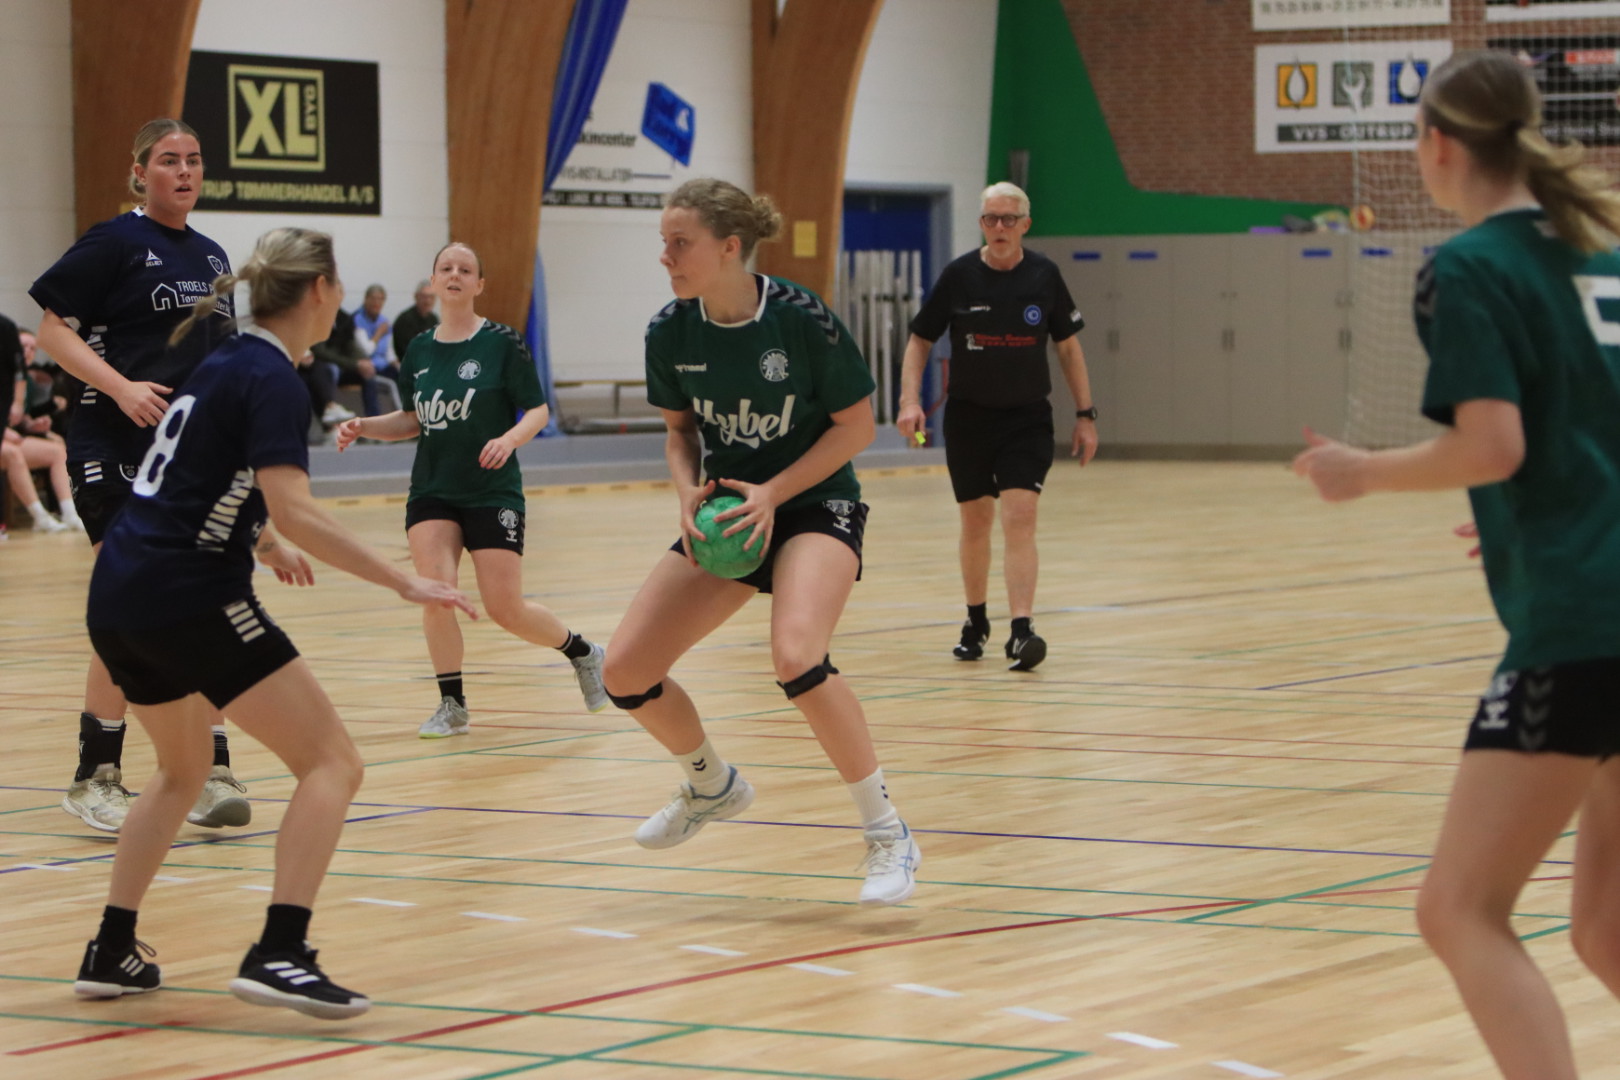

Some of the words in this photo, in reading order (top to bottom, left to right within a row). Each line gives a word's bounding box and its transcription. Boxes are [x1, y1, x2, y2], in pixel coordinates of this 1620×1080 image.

[237, 79, 317, 157] XL
[304, 83, 316, 131] BYG
[1292, 125, 1328, 141] VVS
[200, 179, 233, 199] TRUP
[236, 180, 346, 203] TØMMERHANDEL
[347, 185, 374, 205] A/S
[176, 281, 208, 294] TROELS
[132, 394, 197, 497] 8
